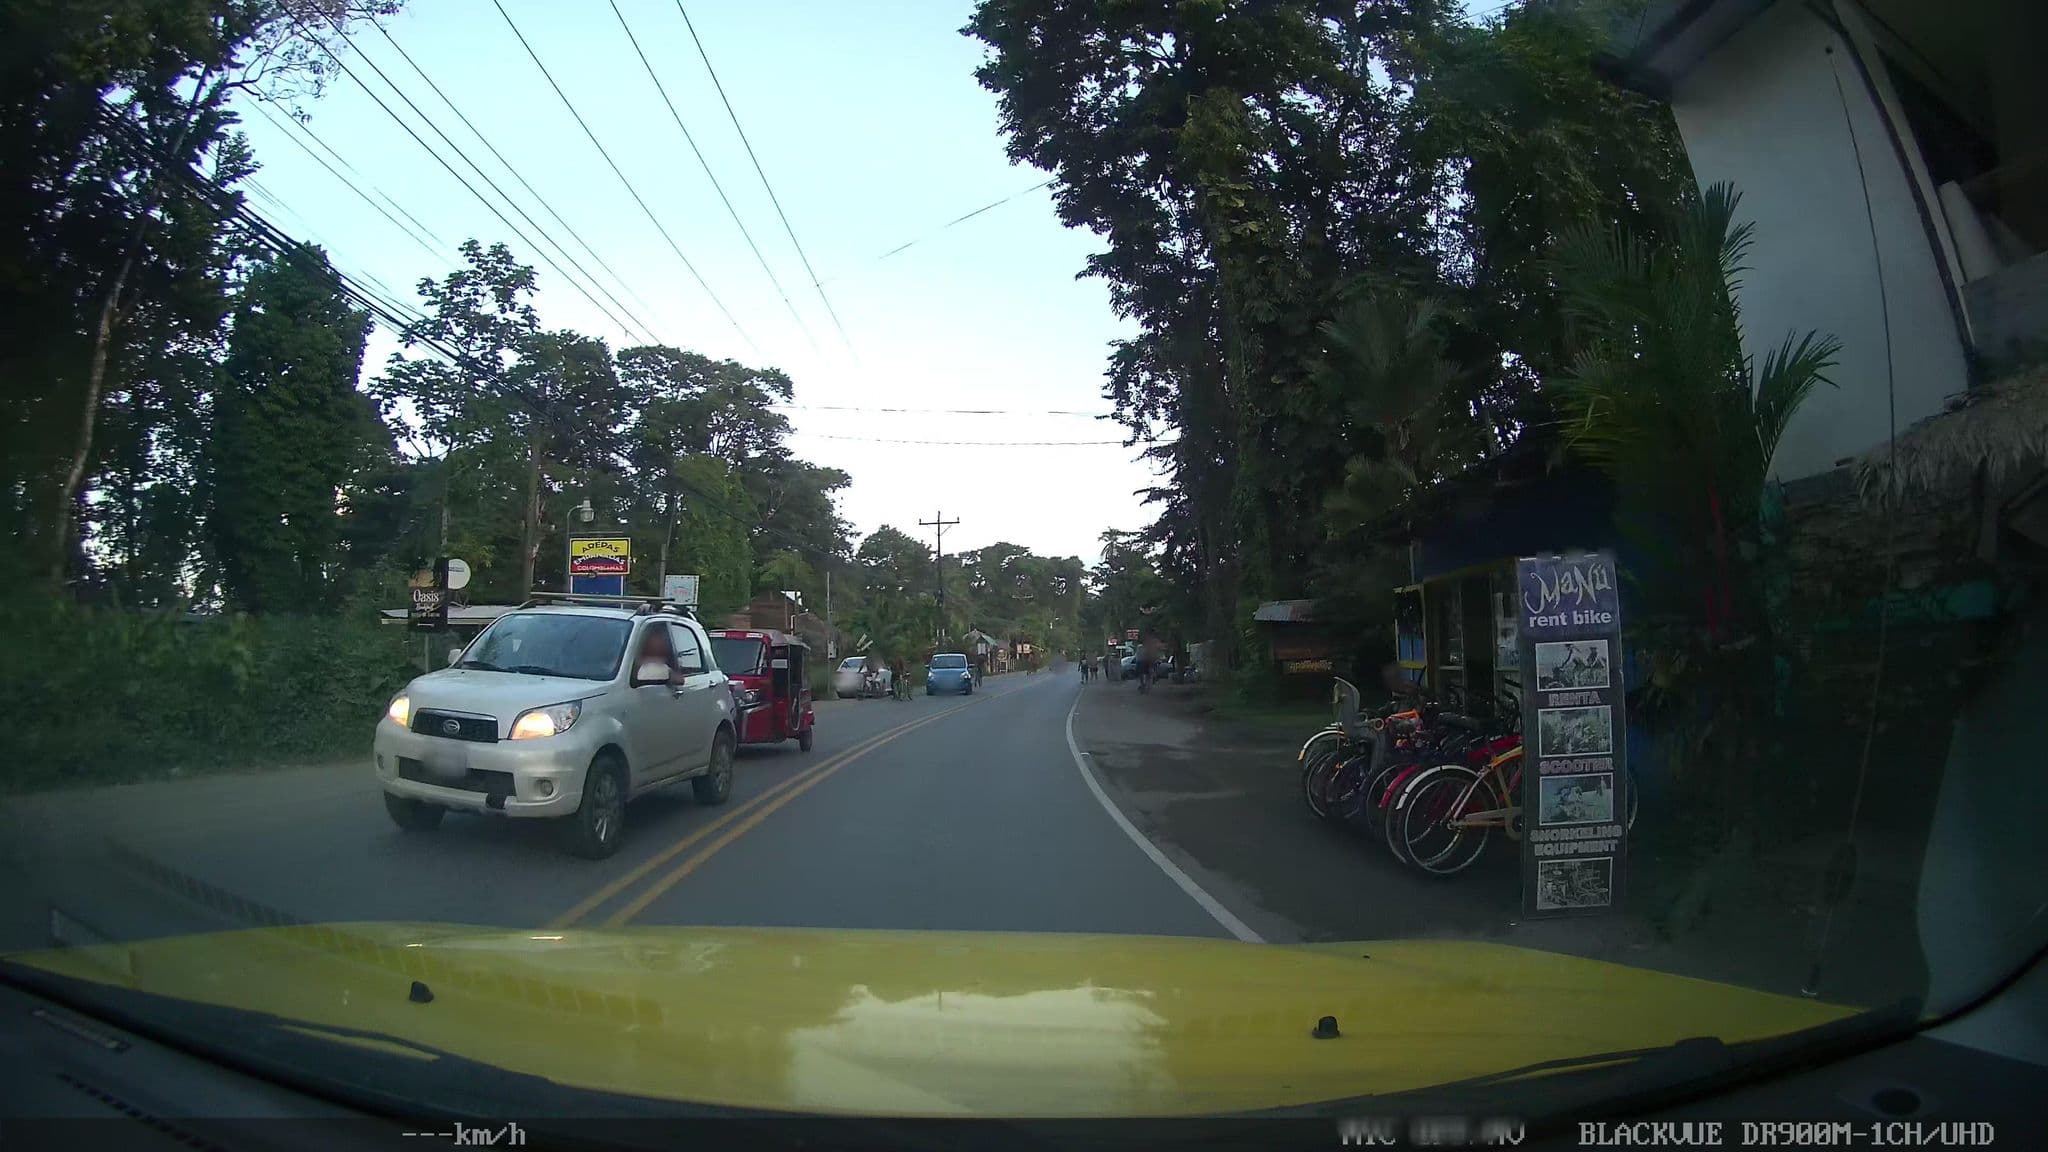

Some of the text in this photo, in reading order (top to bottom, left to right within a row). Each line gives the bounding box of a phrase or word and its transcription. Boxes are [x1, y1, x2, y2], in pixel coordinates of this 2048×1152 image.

[413, 589, 439, 603] Oasis
[1529, 609, 1612, 627] rent bike
[1549, 691, 1601, 706] RENTA
[1540, 758, 1614, 774] SCOOTER
[1530, 825, 1622, 842] SNORKELING
[1535, 840, 1618, 856] EQUIPMENT
